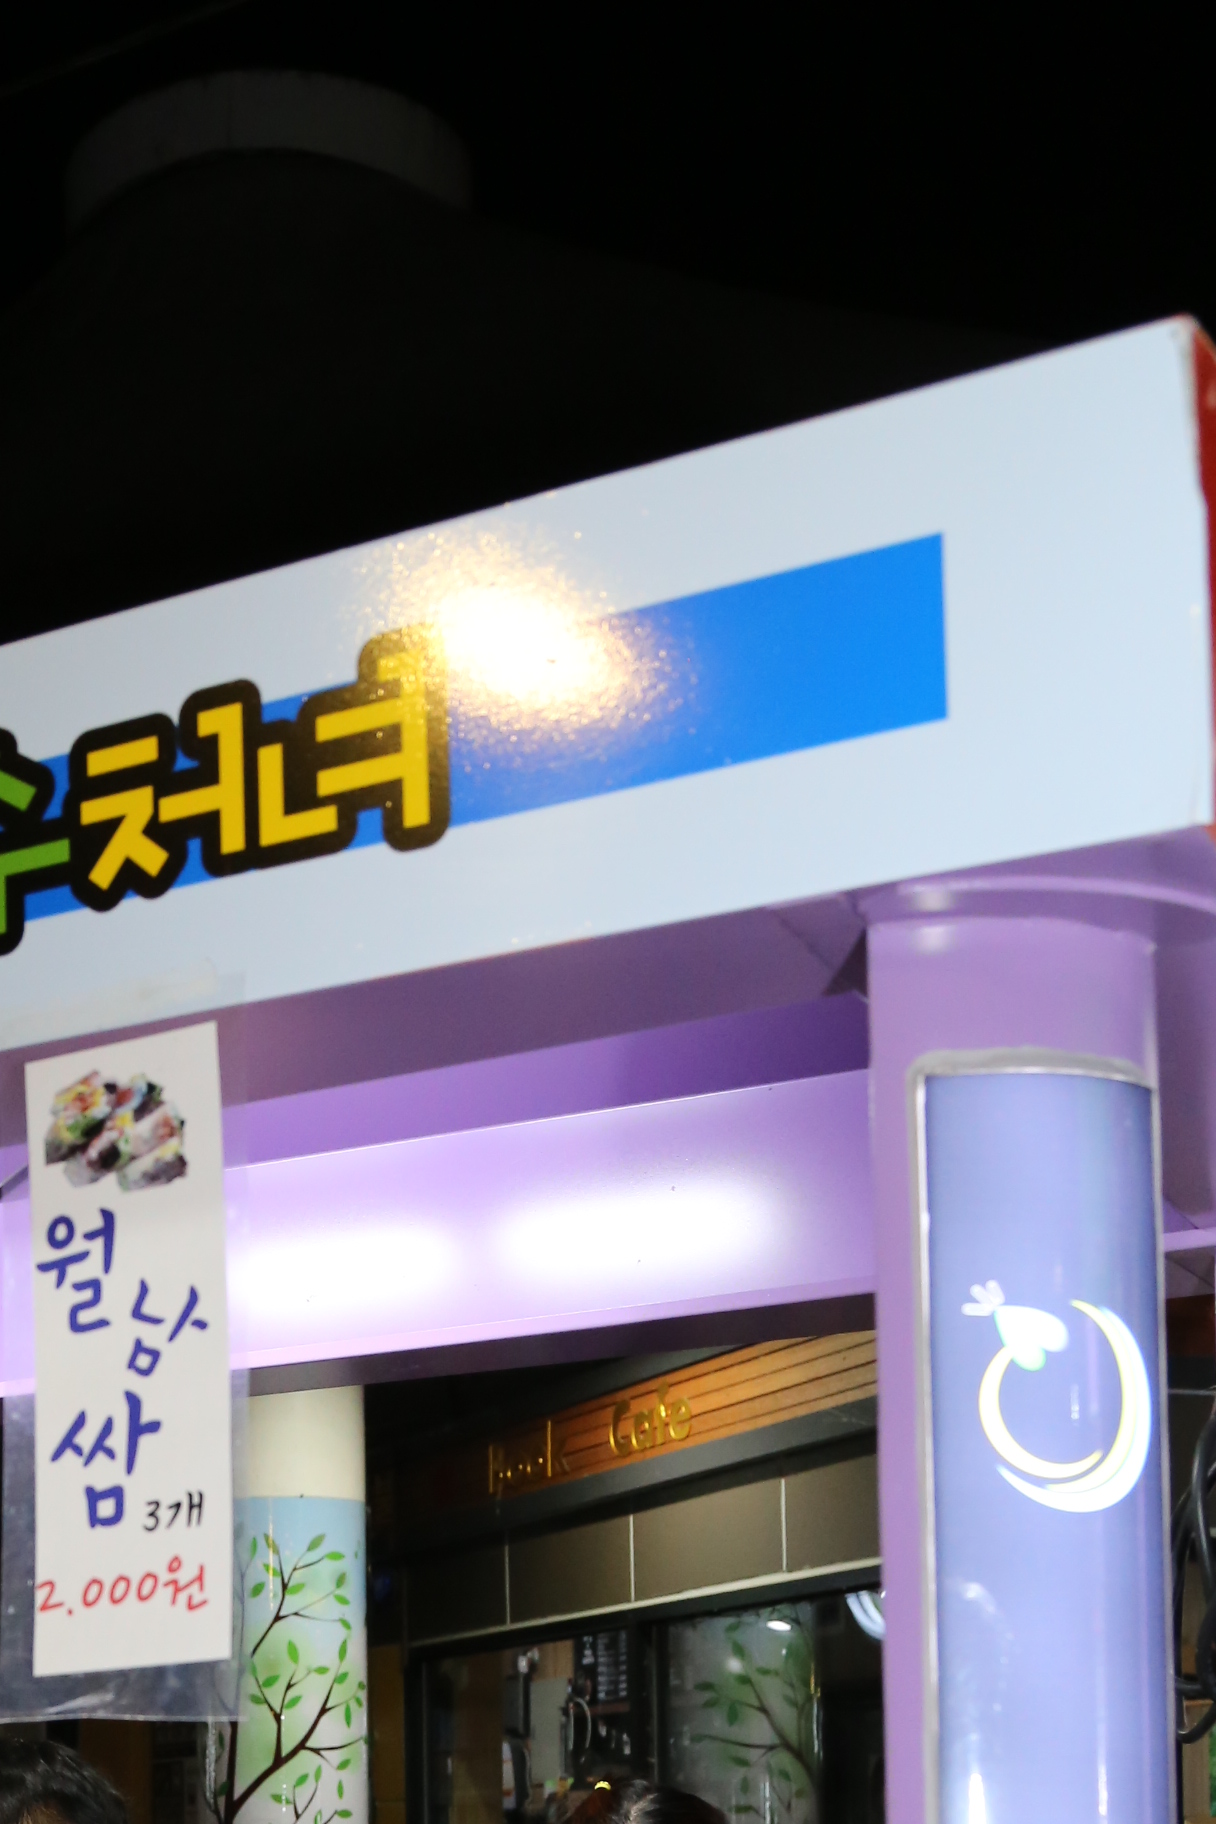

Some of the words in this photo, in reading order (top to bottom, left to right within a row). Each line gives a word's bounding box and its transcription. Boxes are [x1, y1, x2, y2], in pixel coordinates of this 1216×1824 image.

[36, 1207, 209, 1378] 월남
[50, 1390, 162, 1529] 쌈
[142, 1491, 205, 1533] 3개
